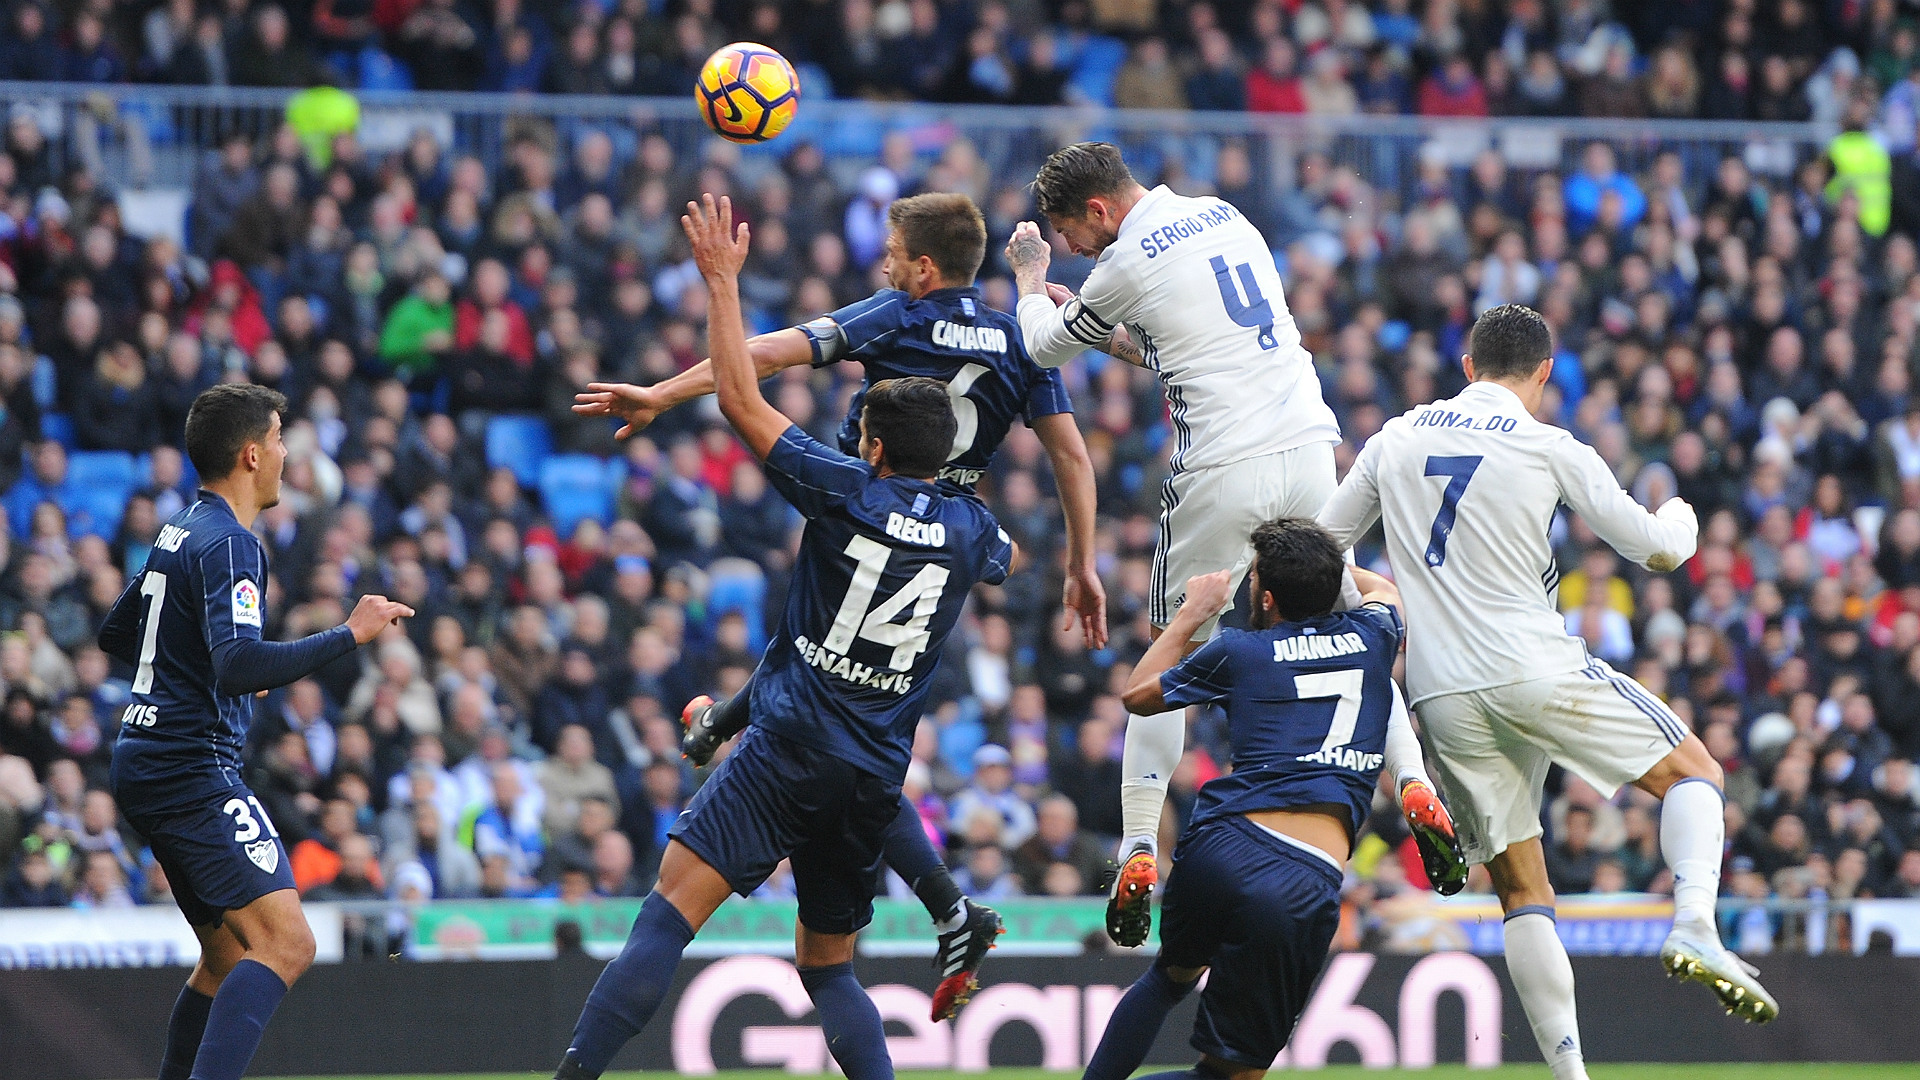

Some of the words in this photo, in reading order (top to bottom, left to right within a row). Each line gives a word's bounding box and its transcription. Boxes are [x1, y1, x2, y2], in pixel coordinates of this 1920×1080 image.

[1198, 204, 1241, 228] RAM
[1208, 255, 1279, 351] 4
[931, 319, 1008, 354] CAMACHO
[1413, 409, 1518, 433] RONALDO
[886, 511, 946, 548] RECIO
[1424, 455, 1485, 567] 7
[823, 534, 951, 673] 14
[794, 635, 914, 695] BENAHAVIS
[1272, 632, 1368, 663] JUANKAR
[1293, 668, 1365, 752] 7
[223, 795, 279, 842] 31
[1196, 952, 1503, 1070] 60
